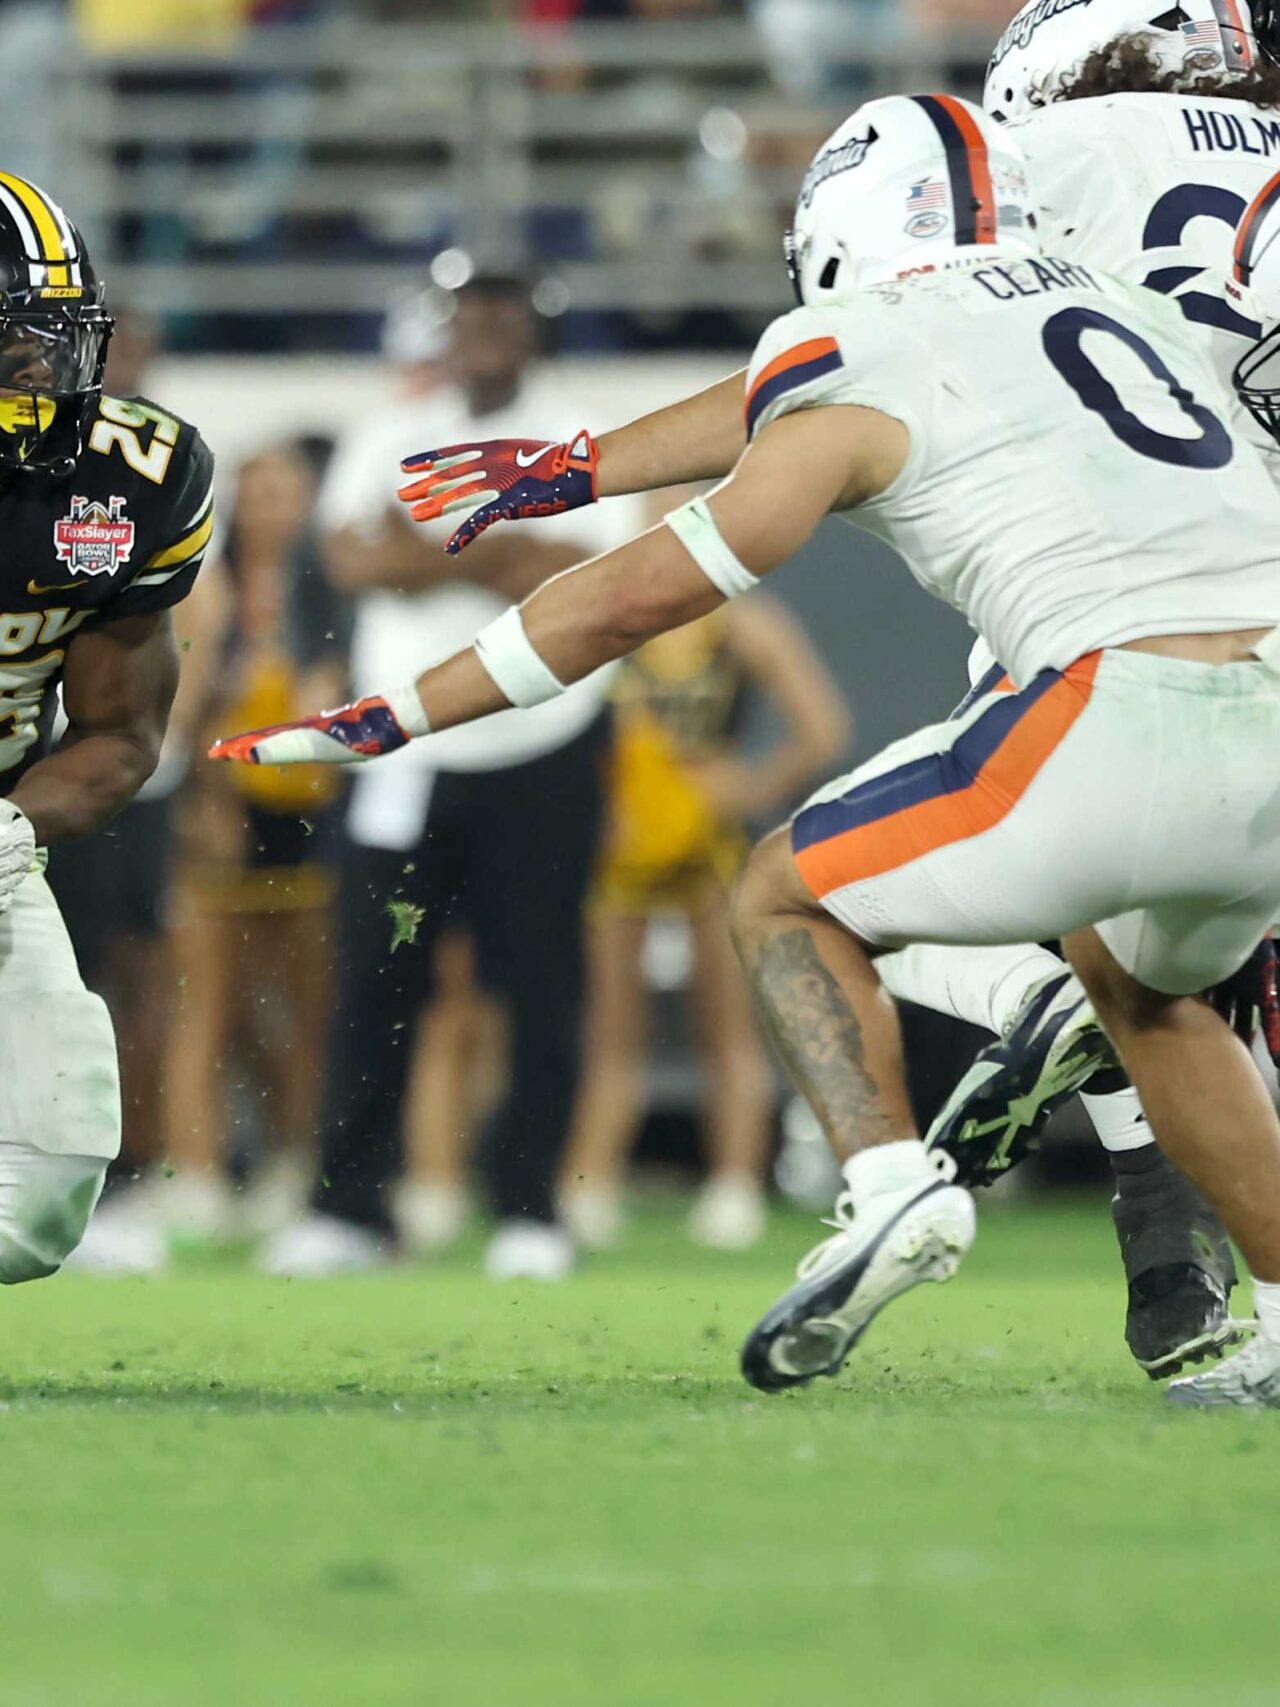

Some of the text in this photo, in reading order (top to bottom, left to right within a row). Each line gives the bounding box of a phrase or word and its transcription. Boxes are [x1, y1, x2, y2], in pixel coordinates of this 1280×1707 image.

[39, 286, 83, 299] MIZZOU
[1040, 306, 1234, 470] 0
[87, 394, 181, 485] 29
[61, 525, 128, 541] TaxSlayer
[77, 549, 111, 557] BOWL
